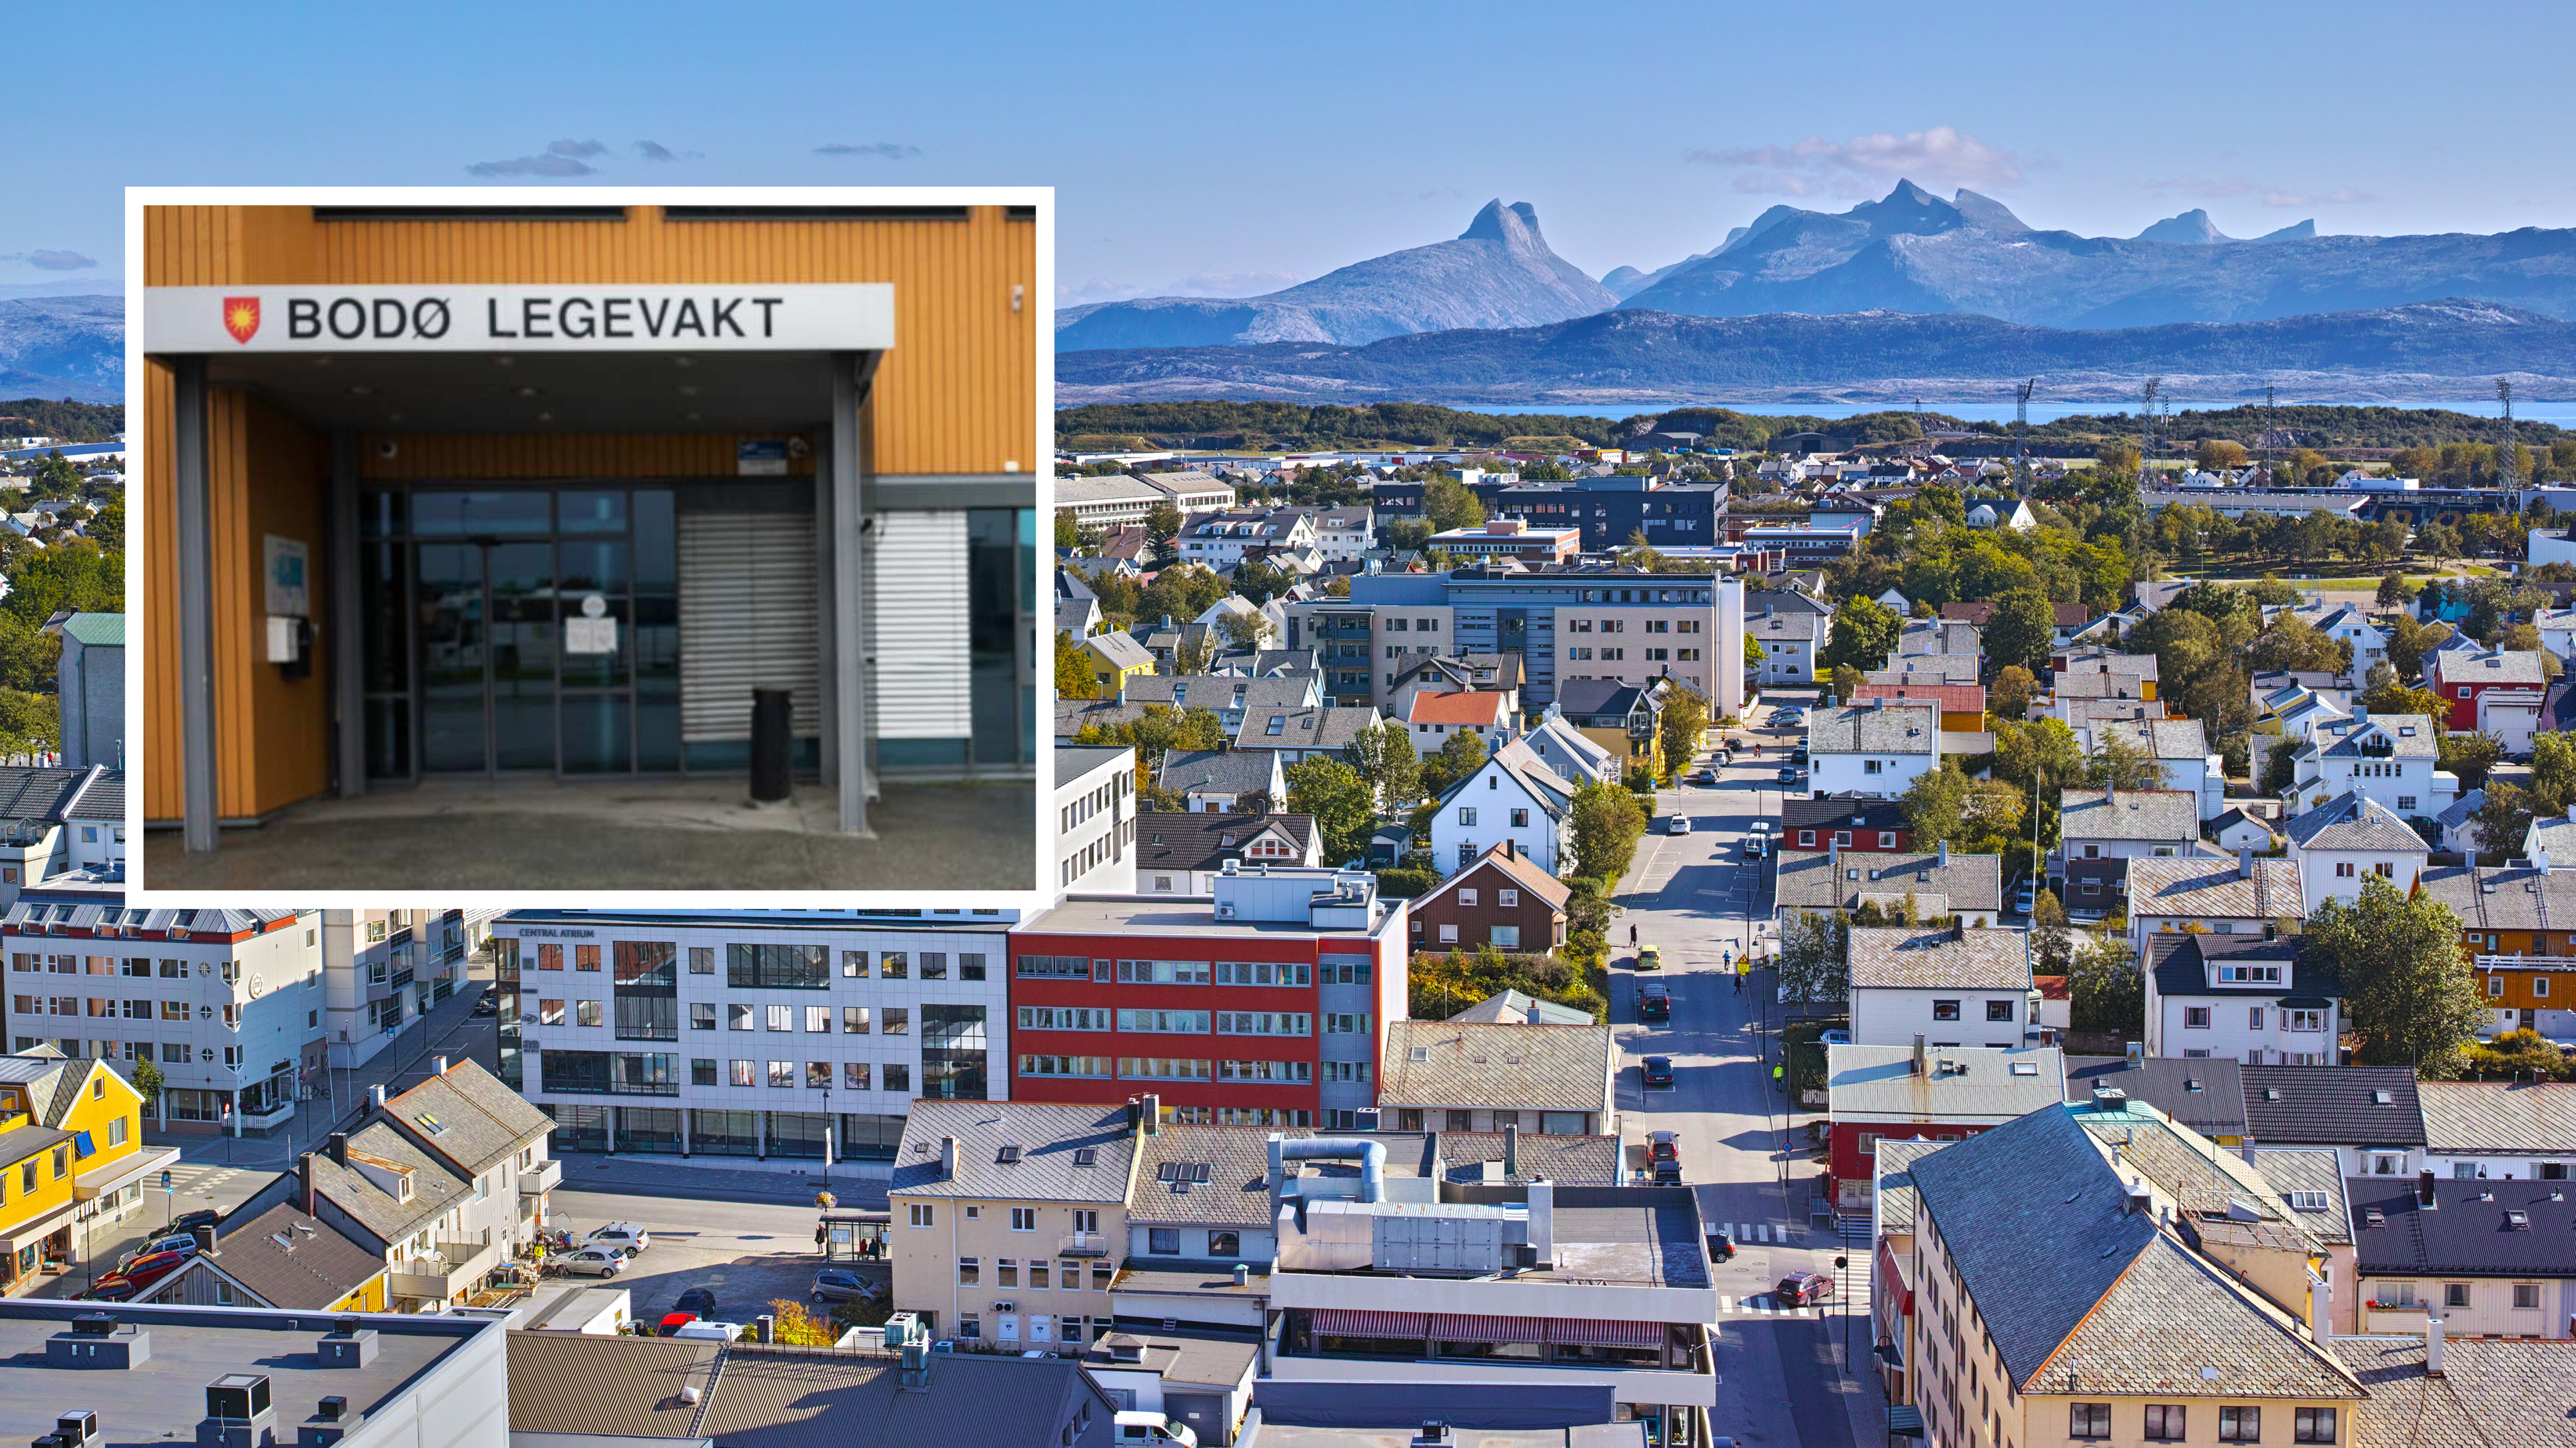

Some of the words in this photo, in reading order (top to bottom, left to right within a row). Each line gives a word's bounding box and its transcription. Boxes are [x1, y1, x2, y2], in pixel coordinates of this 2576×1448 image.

[287, 296, 451, 340] BODØ
[487, 297, 783, 339] LEGEVAKT
[520, 929, 558, 937] CENTRAL
[560, 929, 594, 938] ATRIUM
[523, 1040, 539, 1049] an
